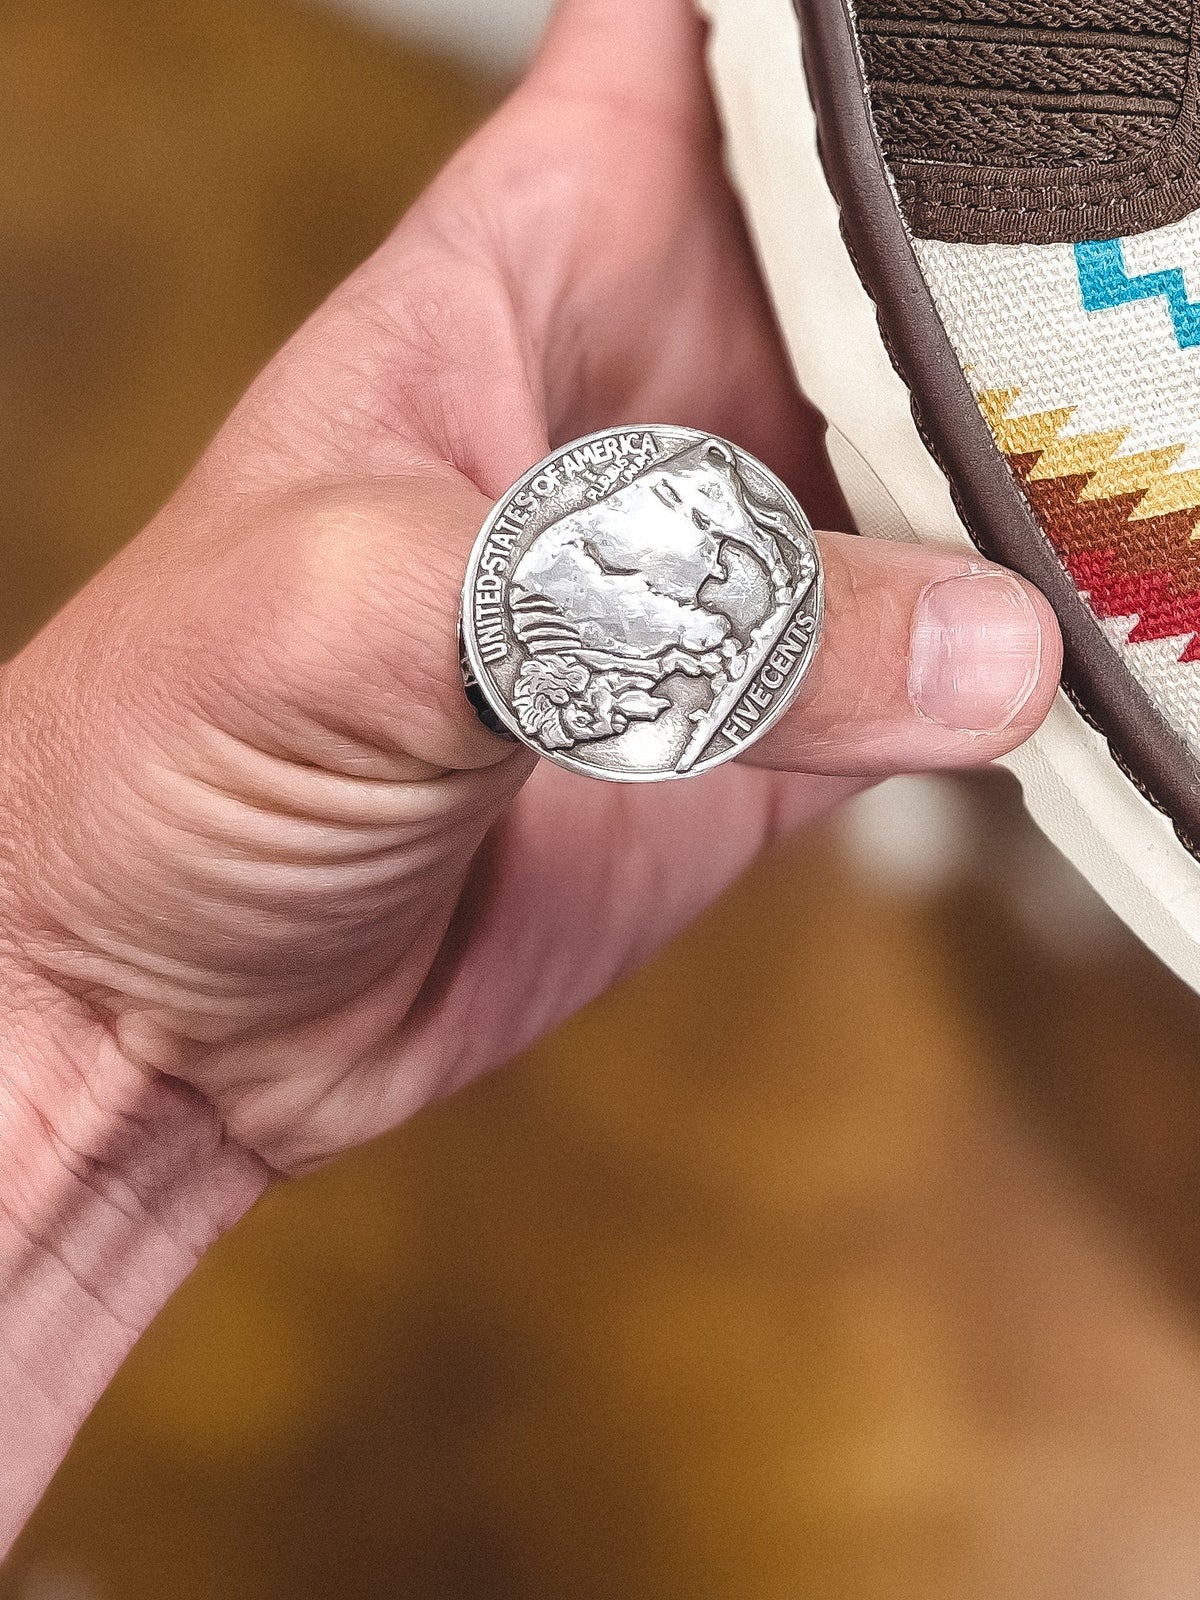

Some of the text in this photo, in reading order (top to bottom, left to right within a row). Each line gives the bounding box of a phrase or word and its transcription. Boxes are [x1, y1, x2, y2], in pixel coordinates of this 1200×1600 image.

[562, 432, 659, 479] AMERICA
[481, 491, 540, 572] STATES
[475, 574, 507, 662] UNITED
[721, 610, 815, 745] FIVE CENTS
